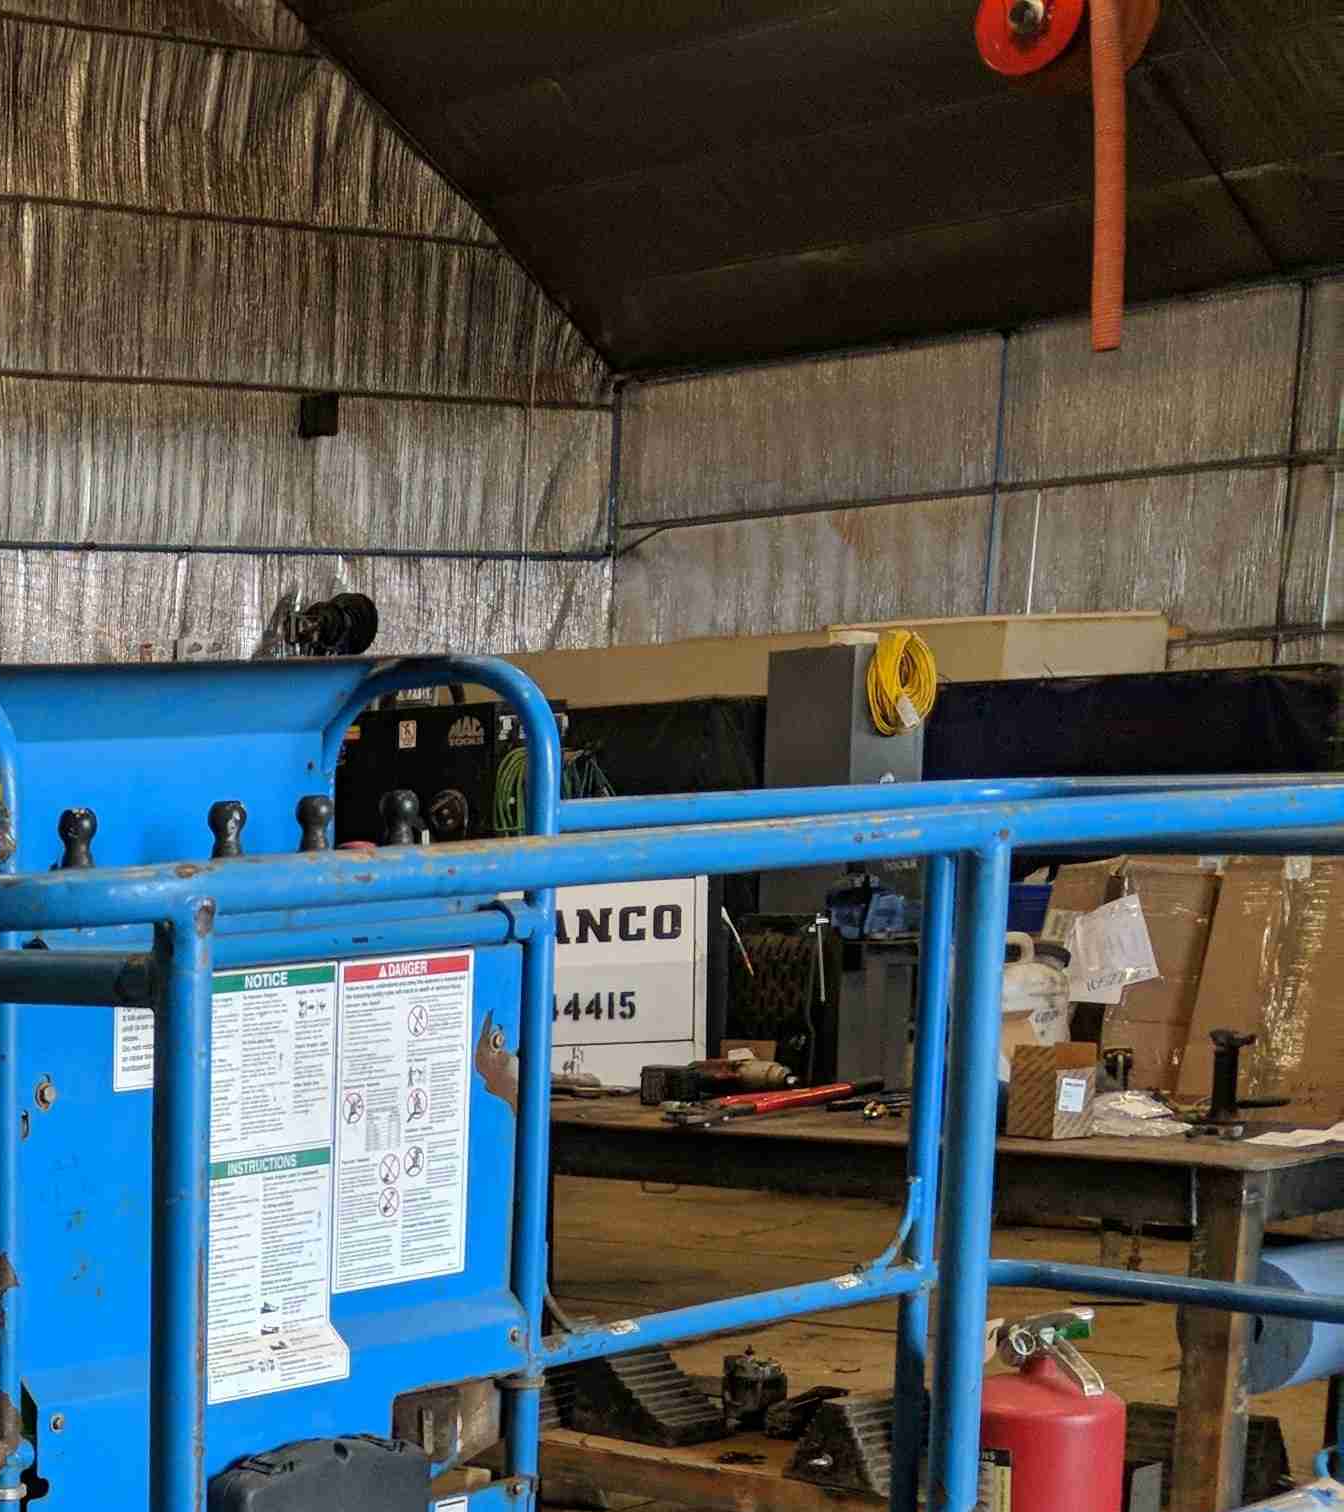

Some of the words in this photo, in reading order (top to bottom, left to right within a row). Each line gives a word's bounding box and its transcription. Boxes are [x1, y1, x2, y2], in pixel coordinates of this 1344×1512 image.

[388, 961, 428, 977] DANGER
[244, 971, 288, 989] NOTICE
[227, 1154, 297, 1176] INSTRUCTIONS
